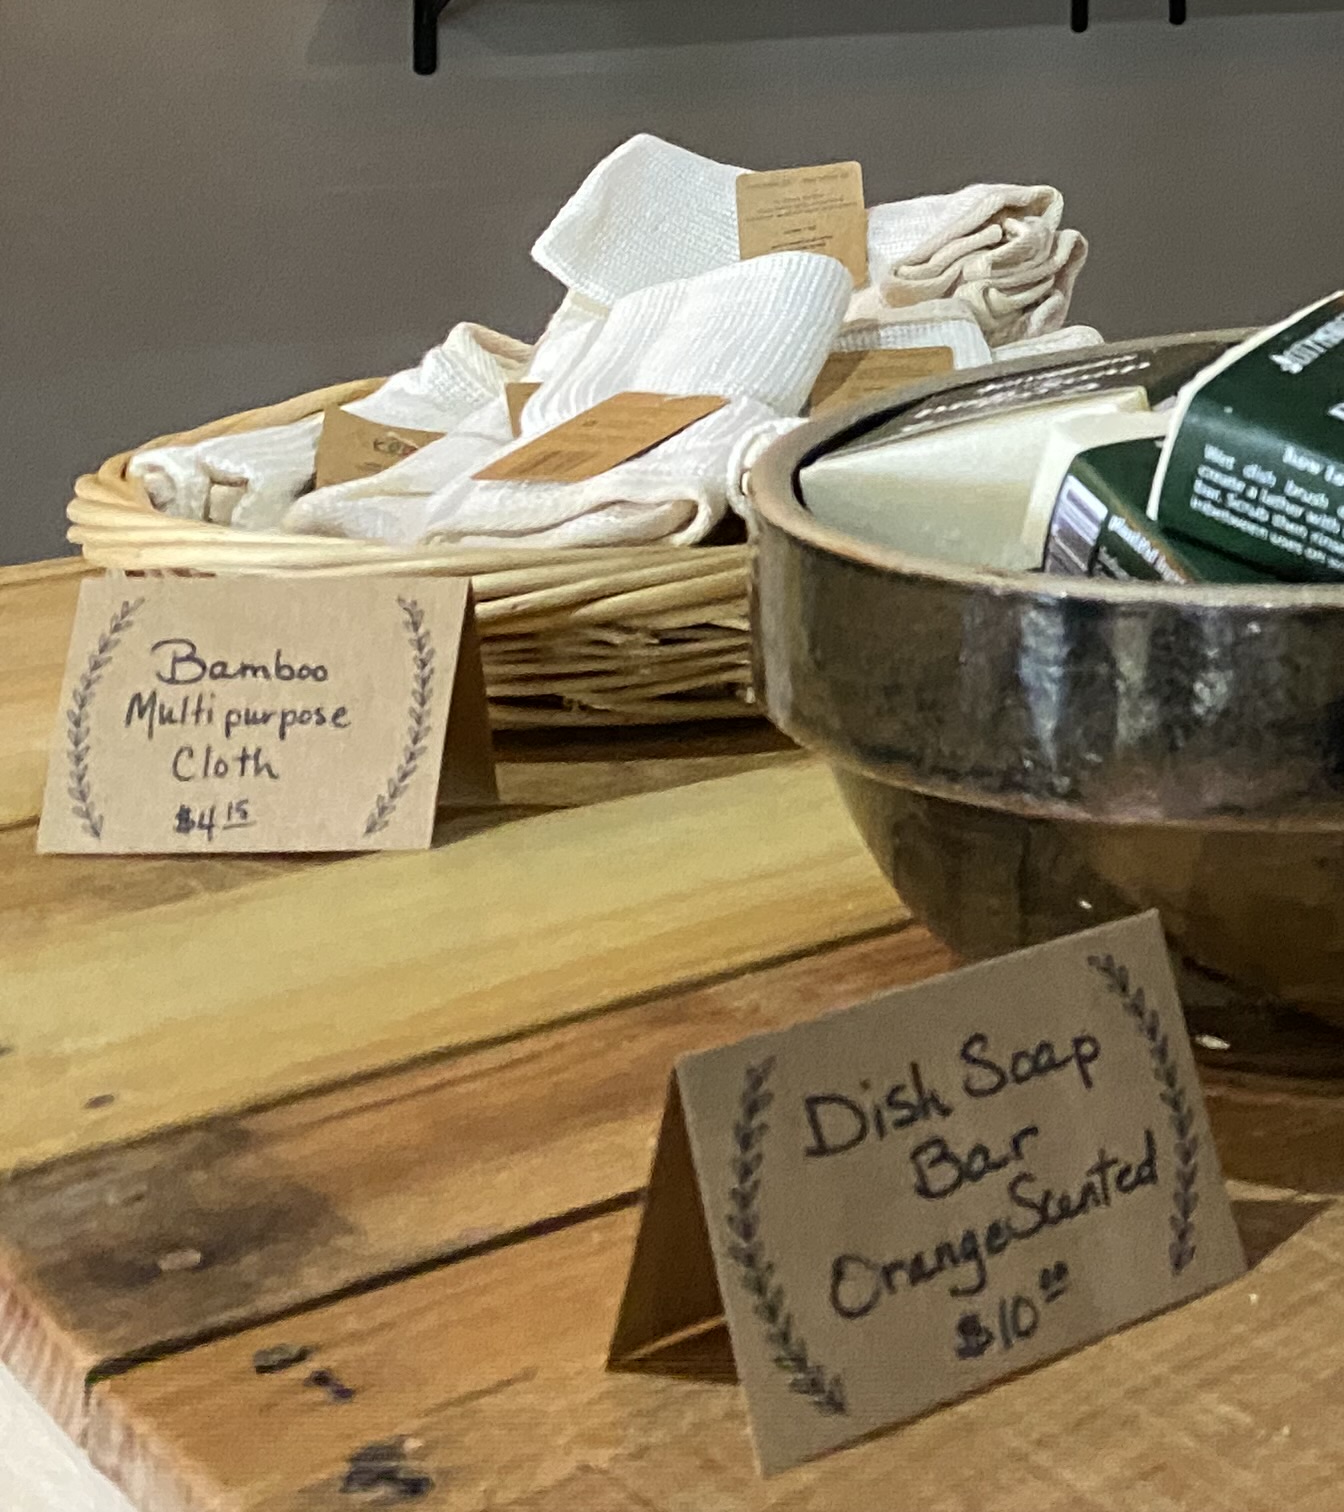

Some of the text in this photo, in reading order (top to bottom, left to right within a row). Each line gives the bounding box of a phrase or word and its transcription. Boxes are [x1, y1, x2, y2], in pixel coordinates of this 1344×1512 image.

[150, 638, 329, 686] Bamboo
[171, 744, 280, 783] Cloth
[804, 1031, 1101, 1158] Dish Soap
[911, 1125, 1040, 1199] Bar
